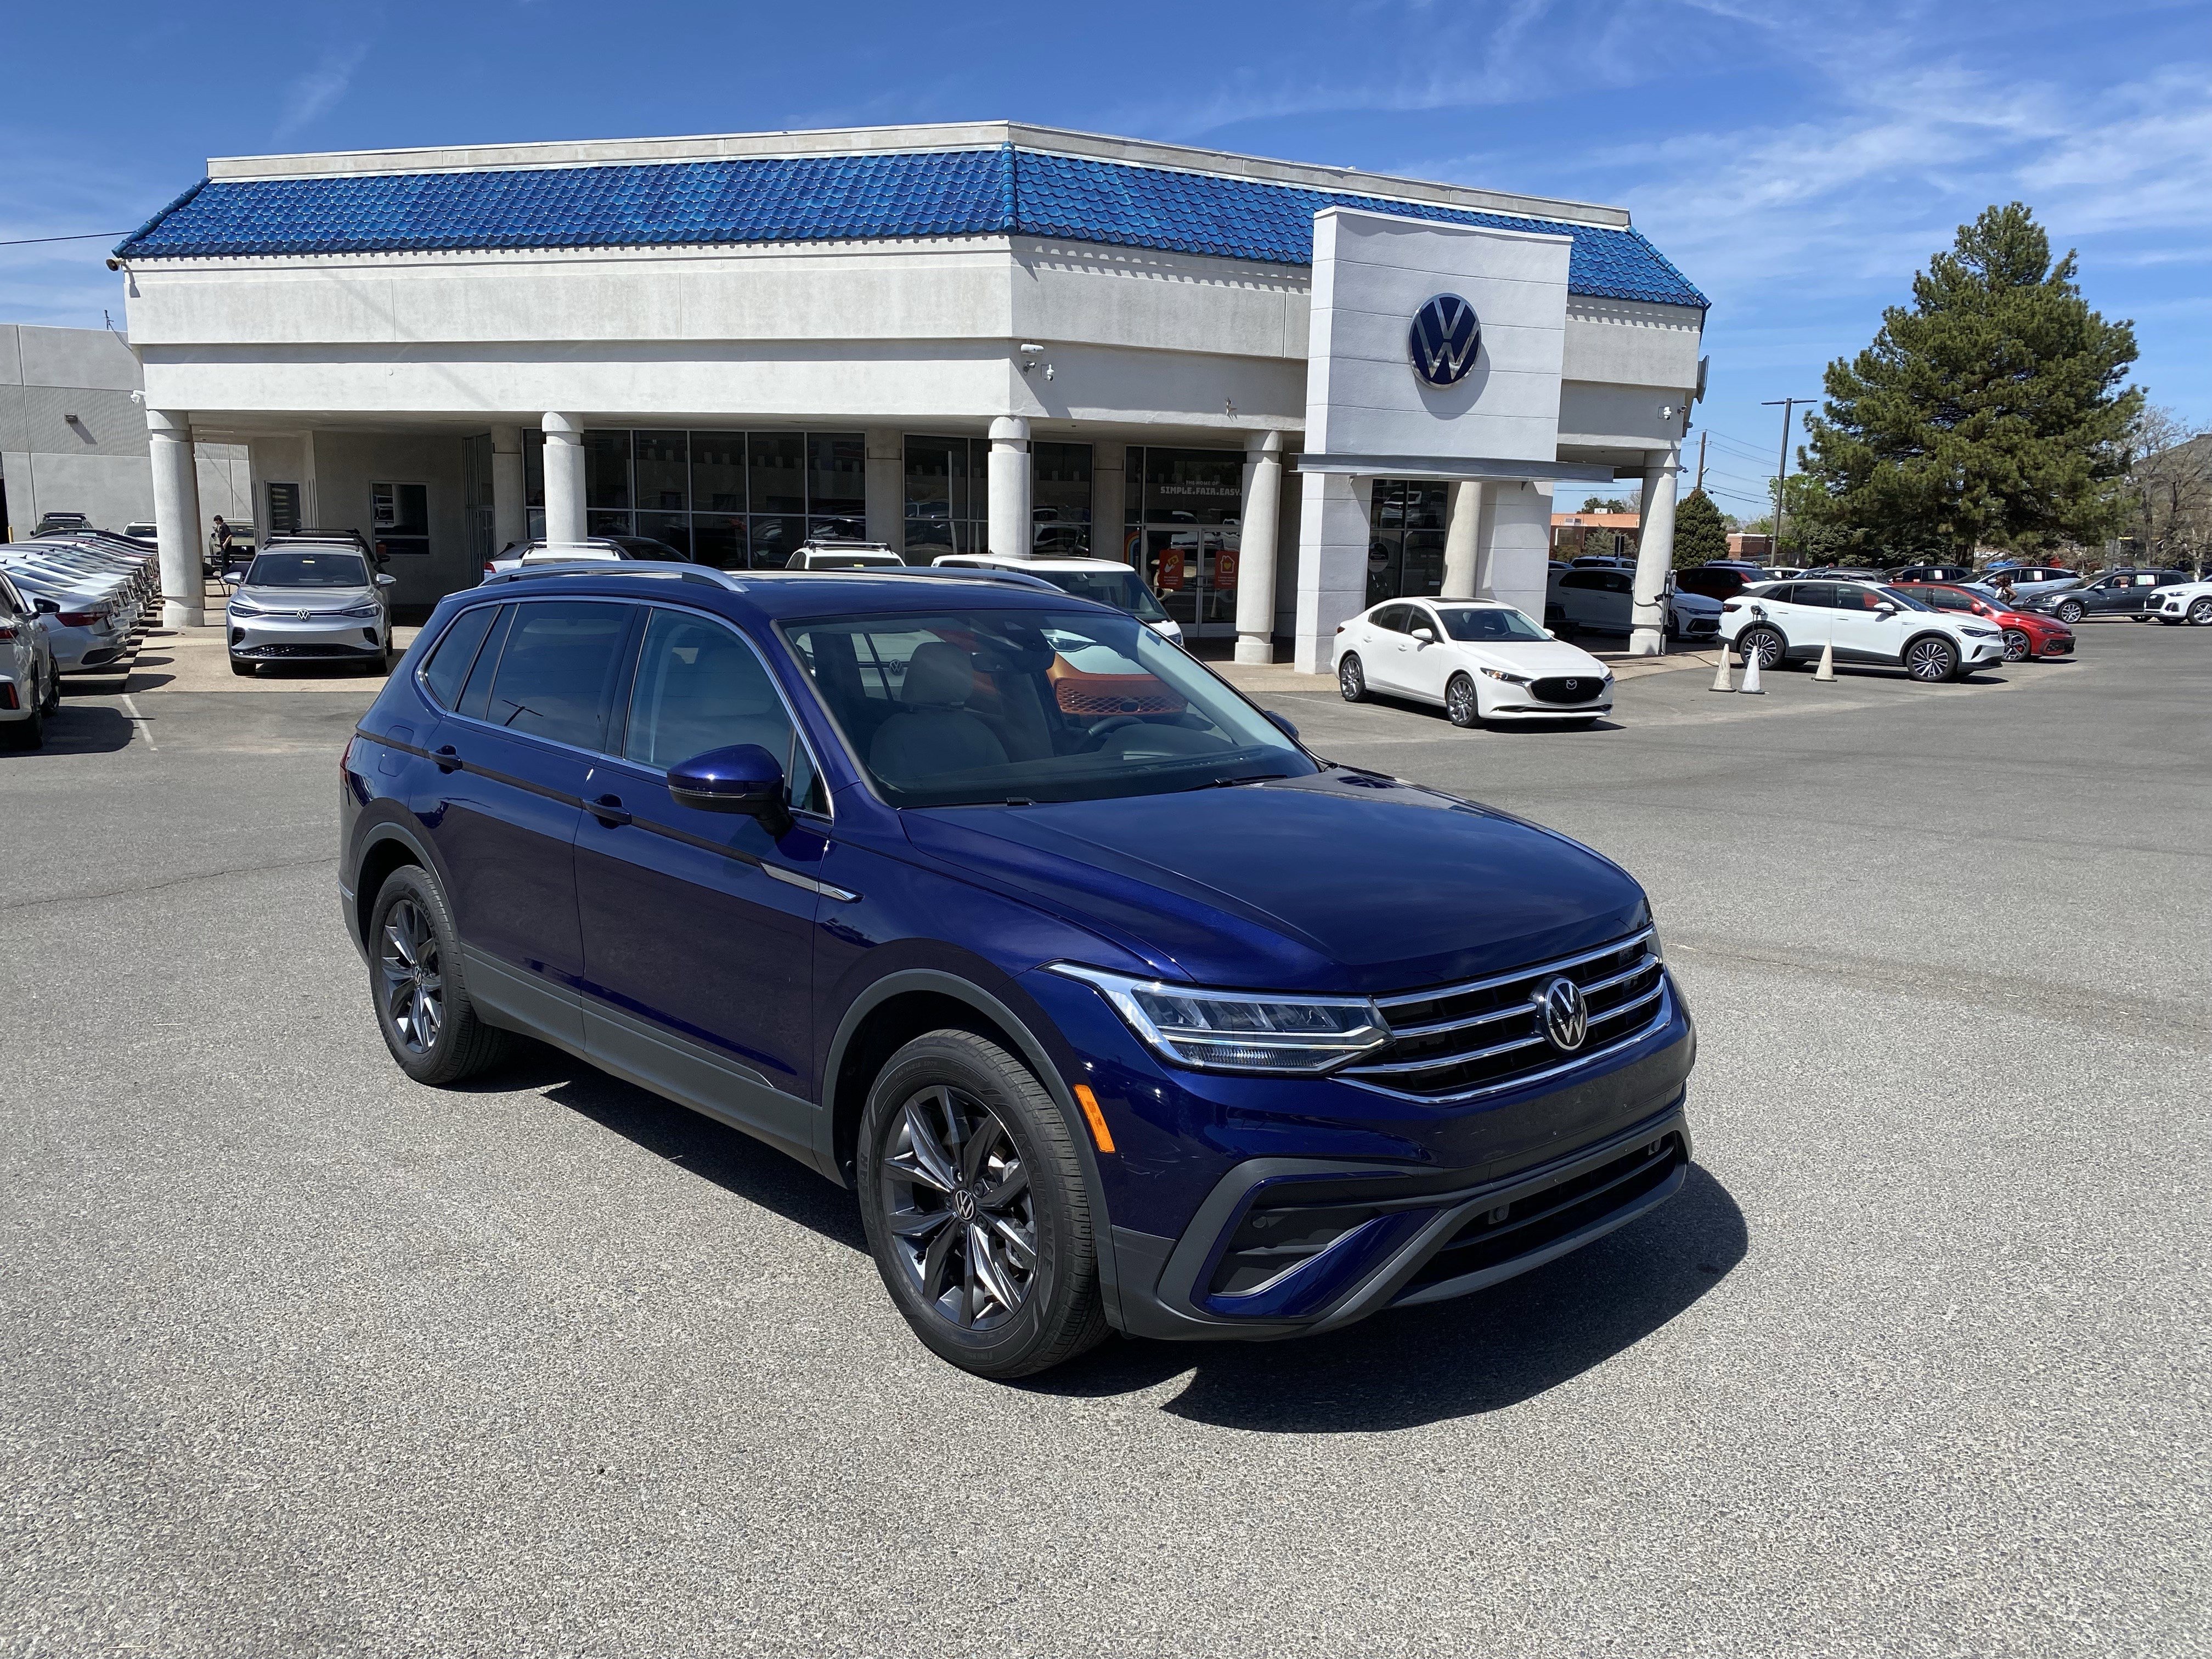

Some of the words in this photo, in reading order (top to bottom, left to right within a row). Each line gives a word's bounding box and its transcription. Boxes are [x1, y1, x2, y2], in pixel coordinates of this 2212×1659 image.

[1407, 292, 1481, 390] VW
[297, 609, 310, 621] VW
[1546, 978, 1587, 1050] VW
[955, 1190, 974, 1220] VW
